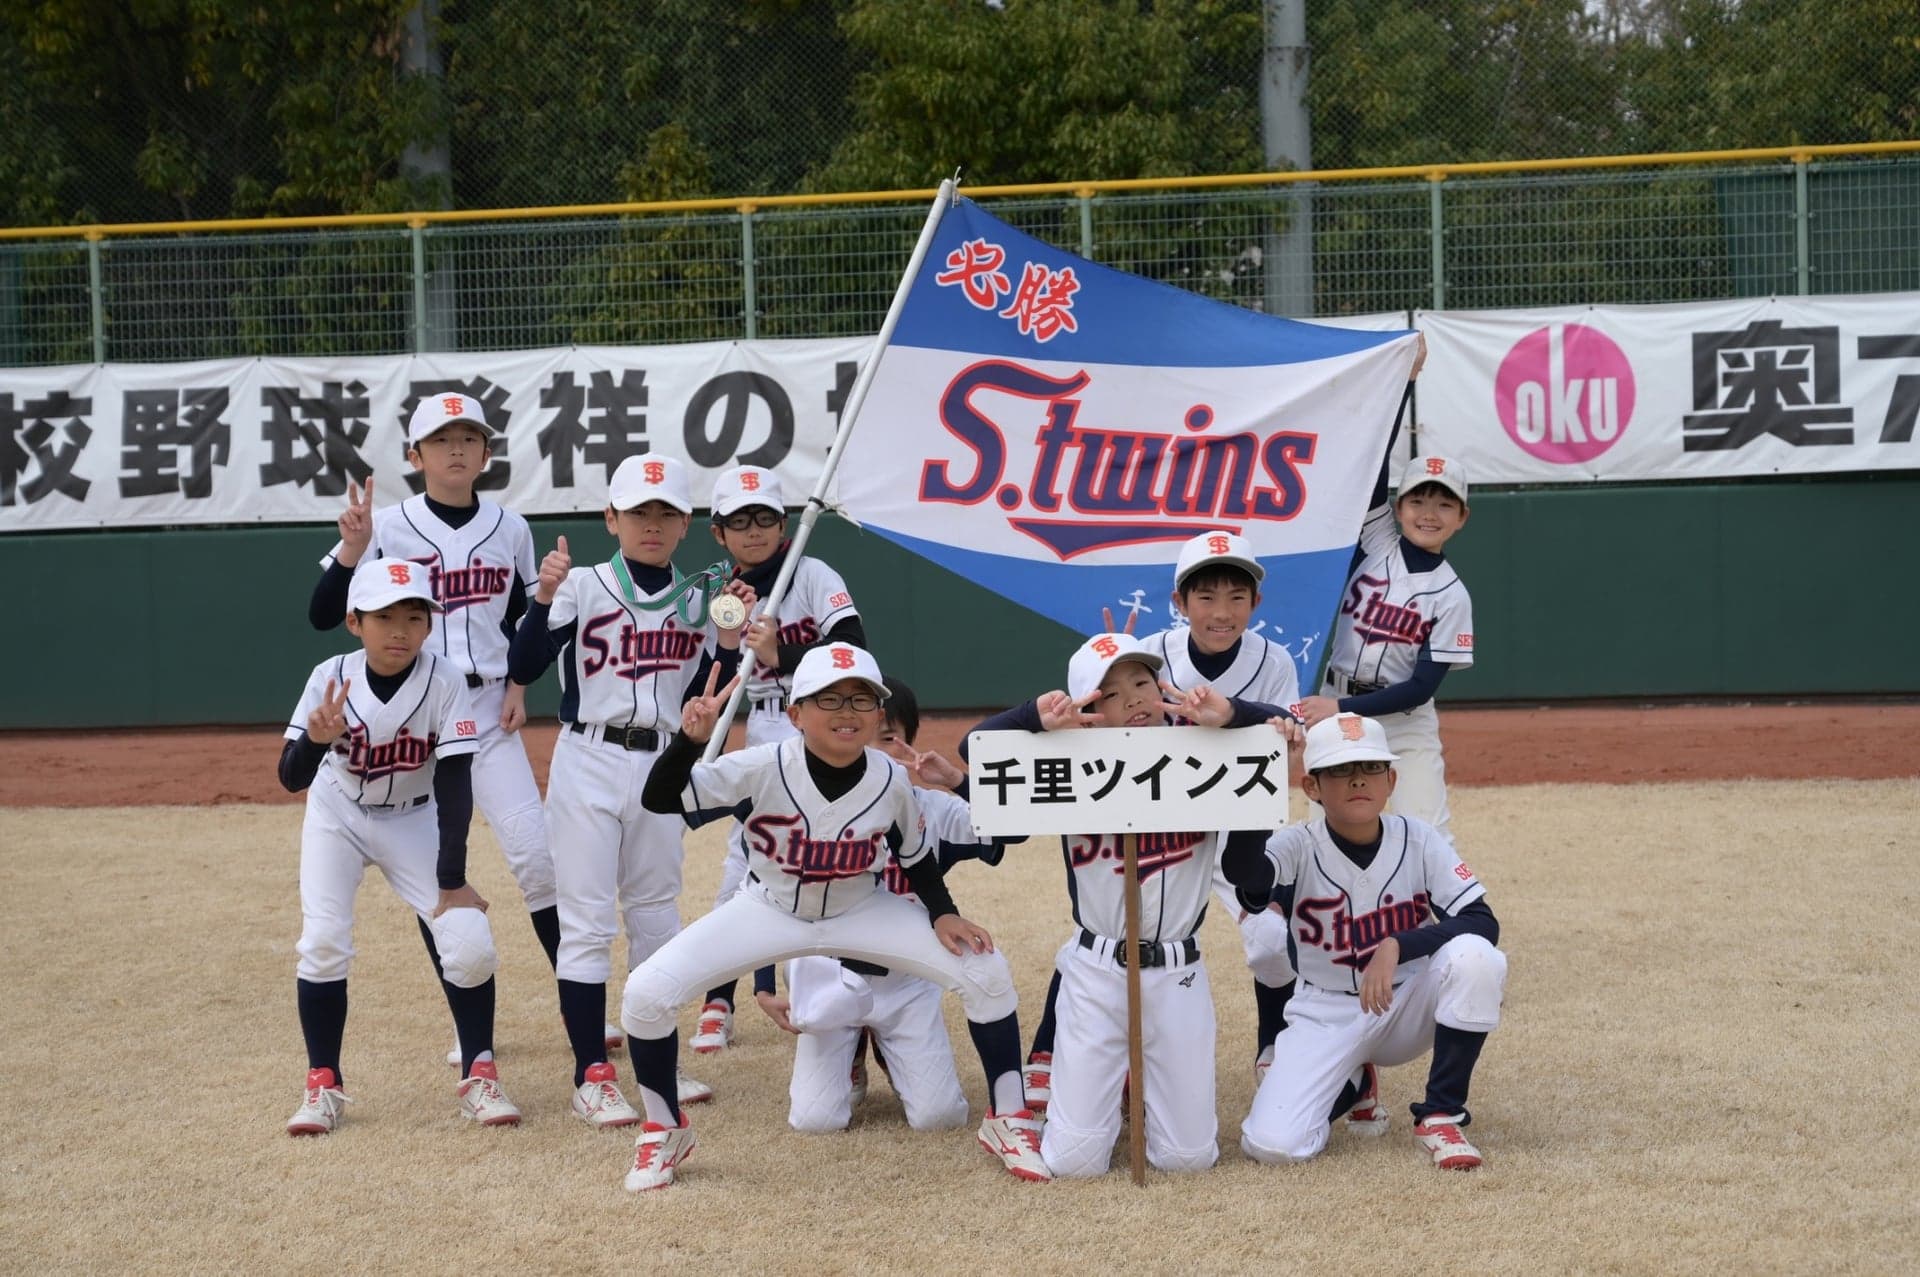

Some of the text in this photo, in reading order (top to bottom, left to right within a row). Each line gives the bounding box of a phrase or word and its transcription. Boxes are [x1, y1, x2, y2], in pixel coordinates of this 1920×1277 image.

[937, 238, 1081, 343] 必勝
[0, 360, 858, 507] 校野球発祥の
[978, 750, 1281, 806] 千里ツインズ
